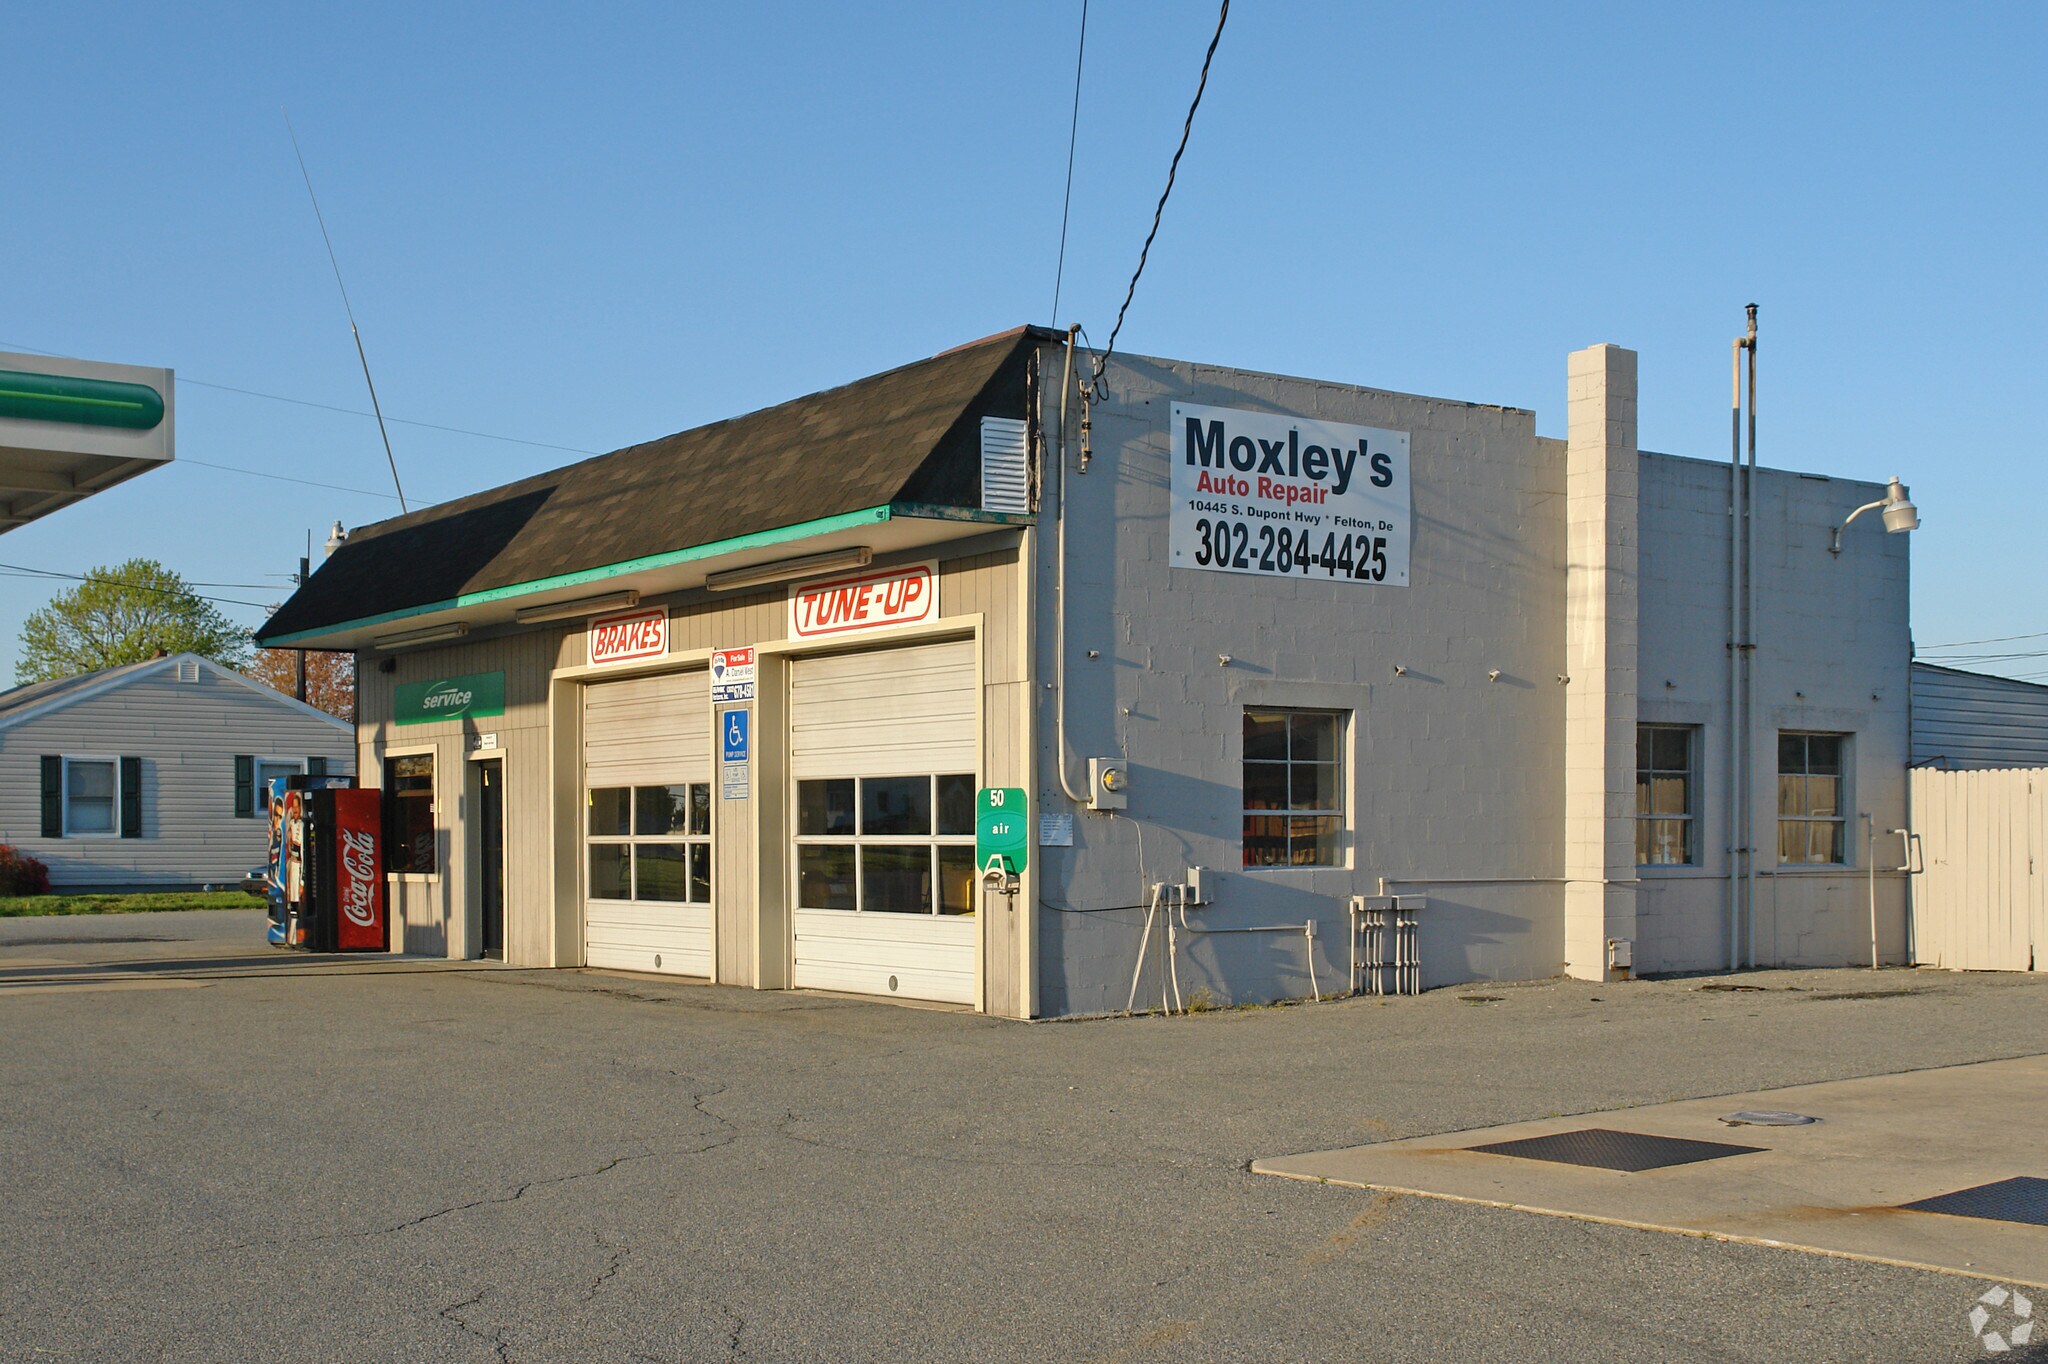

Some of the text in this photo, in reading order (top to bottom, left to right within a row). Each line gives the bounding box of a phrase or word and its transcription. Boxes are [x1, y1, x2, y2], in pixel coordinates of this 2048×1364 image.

[1185, 416, 1393, 496] Moxley's
[1196, 470, 1329, 507] Auto Repair
[1188, 500, 1394, 532] 10445 S. Dupont Hwy Felton, De
[1195, 518, 1387, 582] 302-284-4425
[801, 575, 923, 628] TUNE-UP
[594, 618, 662, 657] BRAKES
[422, 688, 472, 709] service
[990, 789, 1004, 807] 50
[992, 822, 1009, 834] air
